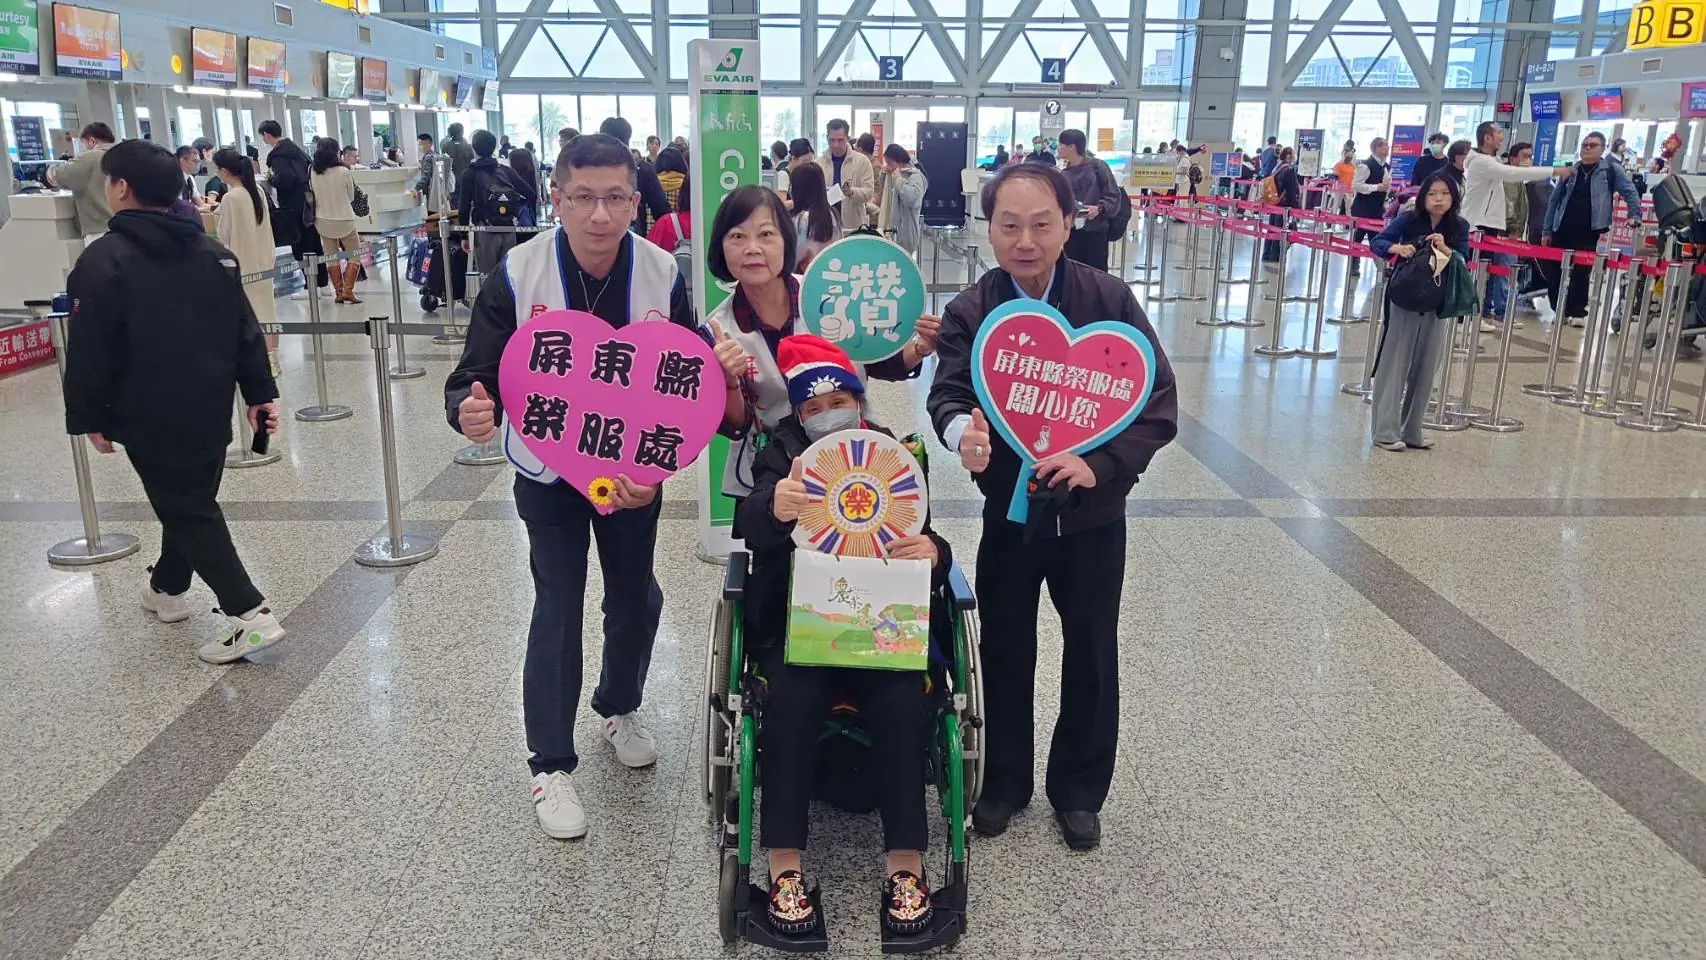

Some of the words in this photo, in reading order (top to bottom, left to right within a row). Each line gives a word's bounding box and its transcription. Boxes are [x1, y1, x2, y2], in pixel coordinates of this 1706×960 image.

[1631, 6, 1654, 45] B
[1667, 7, 1694, 38] B
[885, 59, 897, 78] 3
[1048, 61, 1061, 80] 4
[528, 330, 704, 401] 屏東縣
[992, 347, 1135, 402] 屏東縣榮服處
[1005, 381, 1101, 430] 關心您
[521, 392, 685, 473] 榮服處
